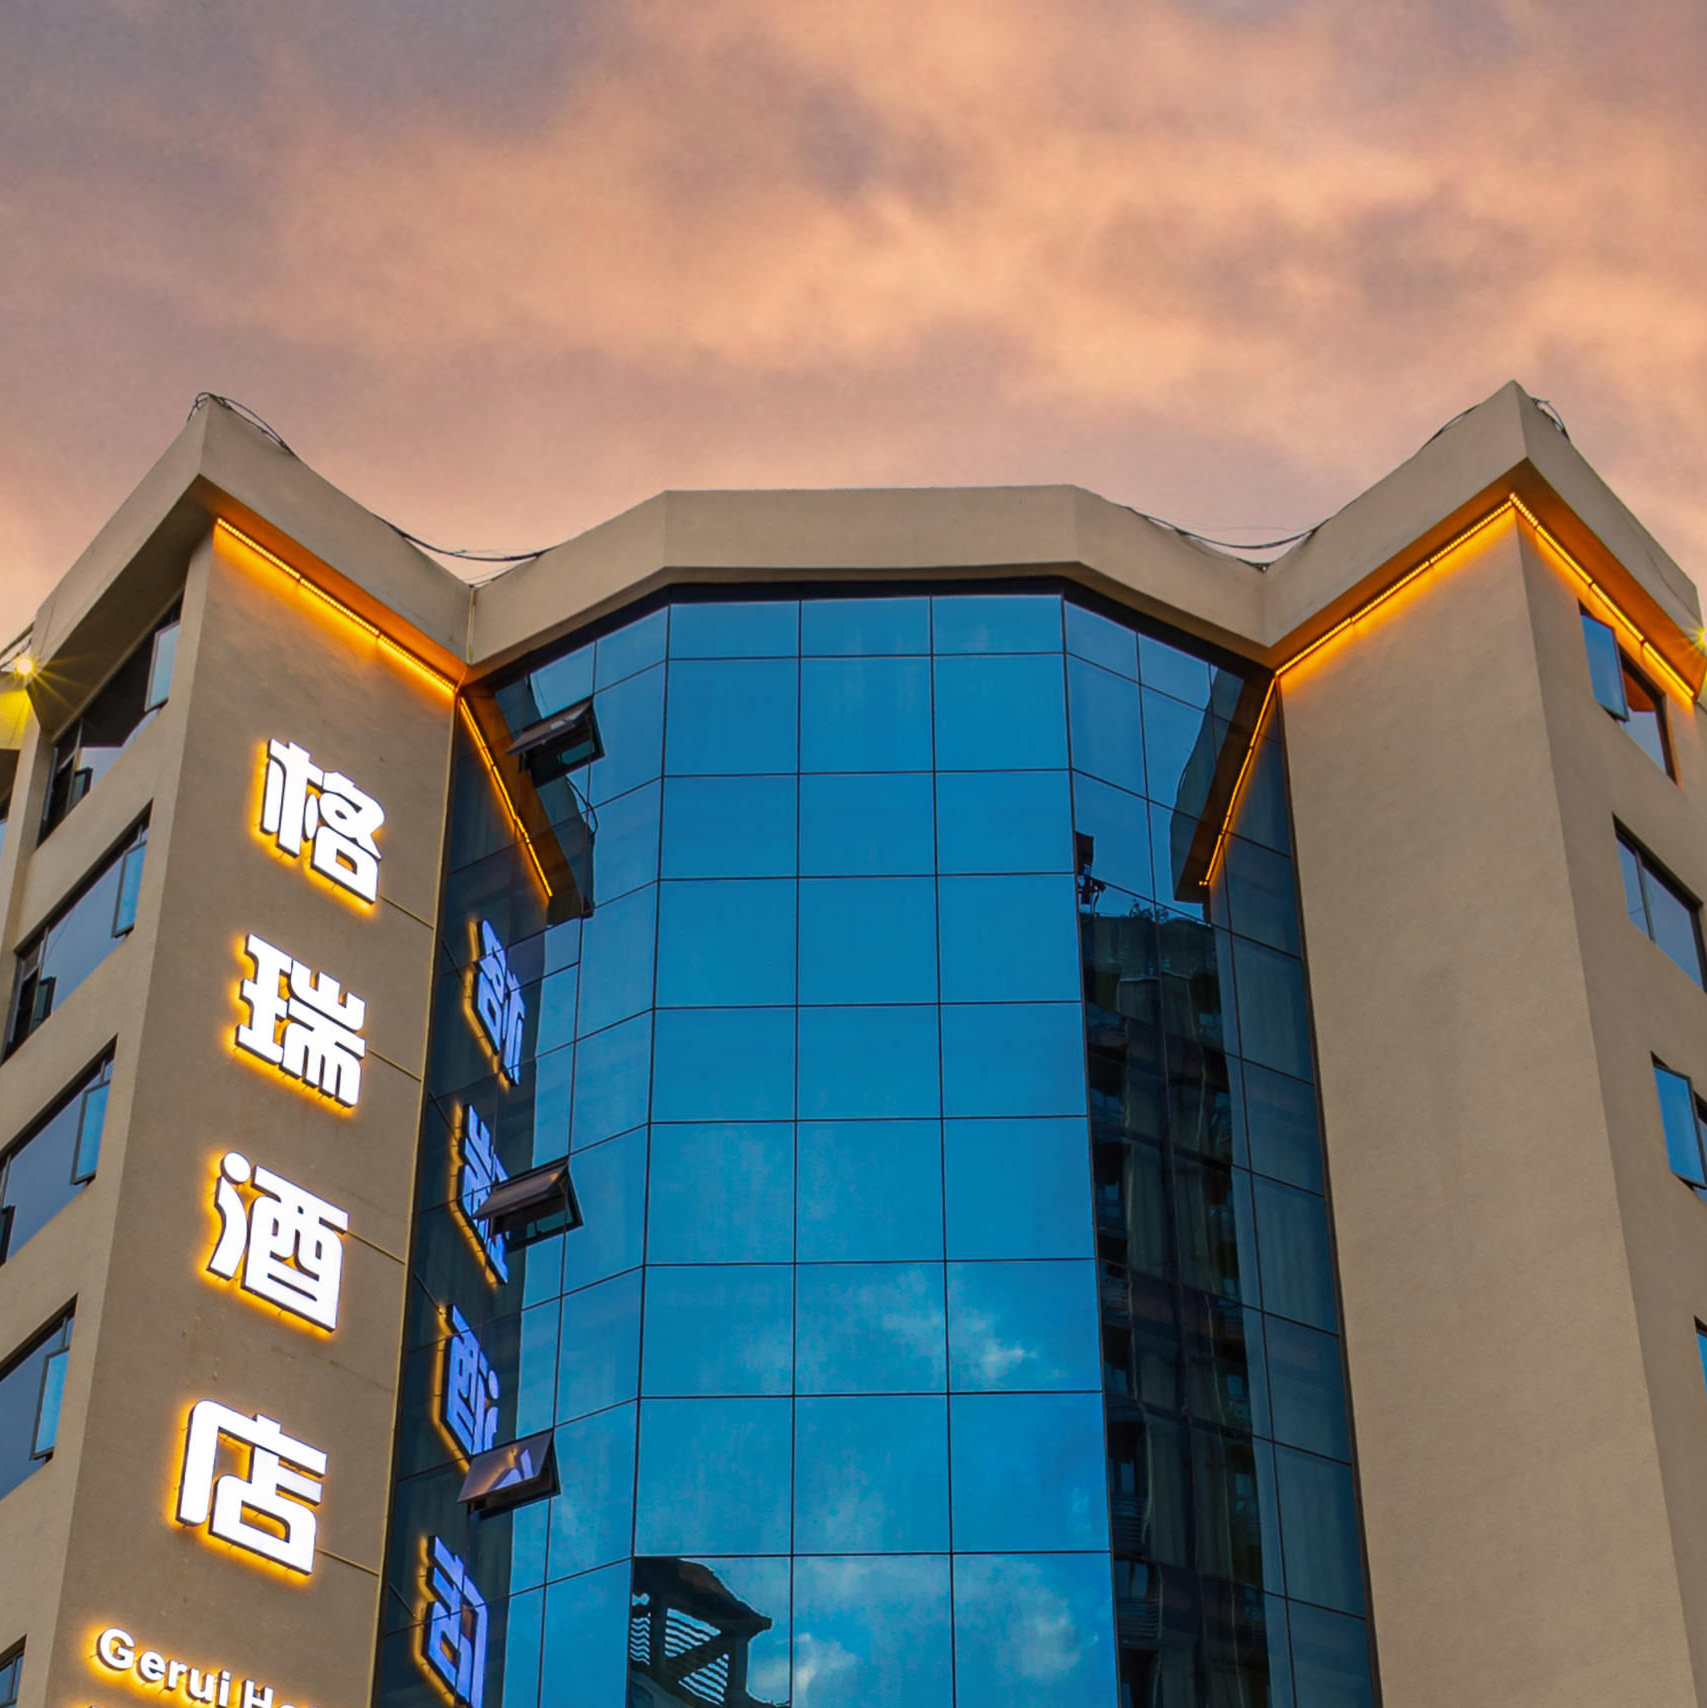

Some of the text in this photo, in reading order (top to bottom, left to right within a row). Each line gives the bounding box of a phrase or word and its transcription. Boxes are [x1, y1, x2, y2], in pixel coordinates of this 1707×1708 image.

[176, 736, 384, 1576] 格瑞酒店
[95, 1627, 231, 1708] Gerui
